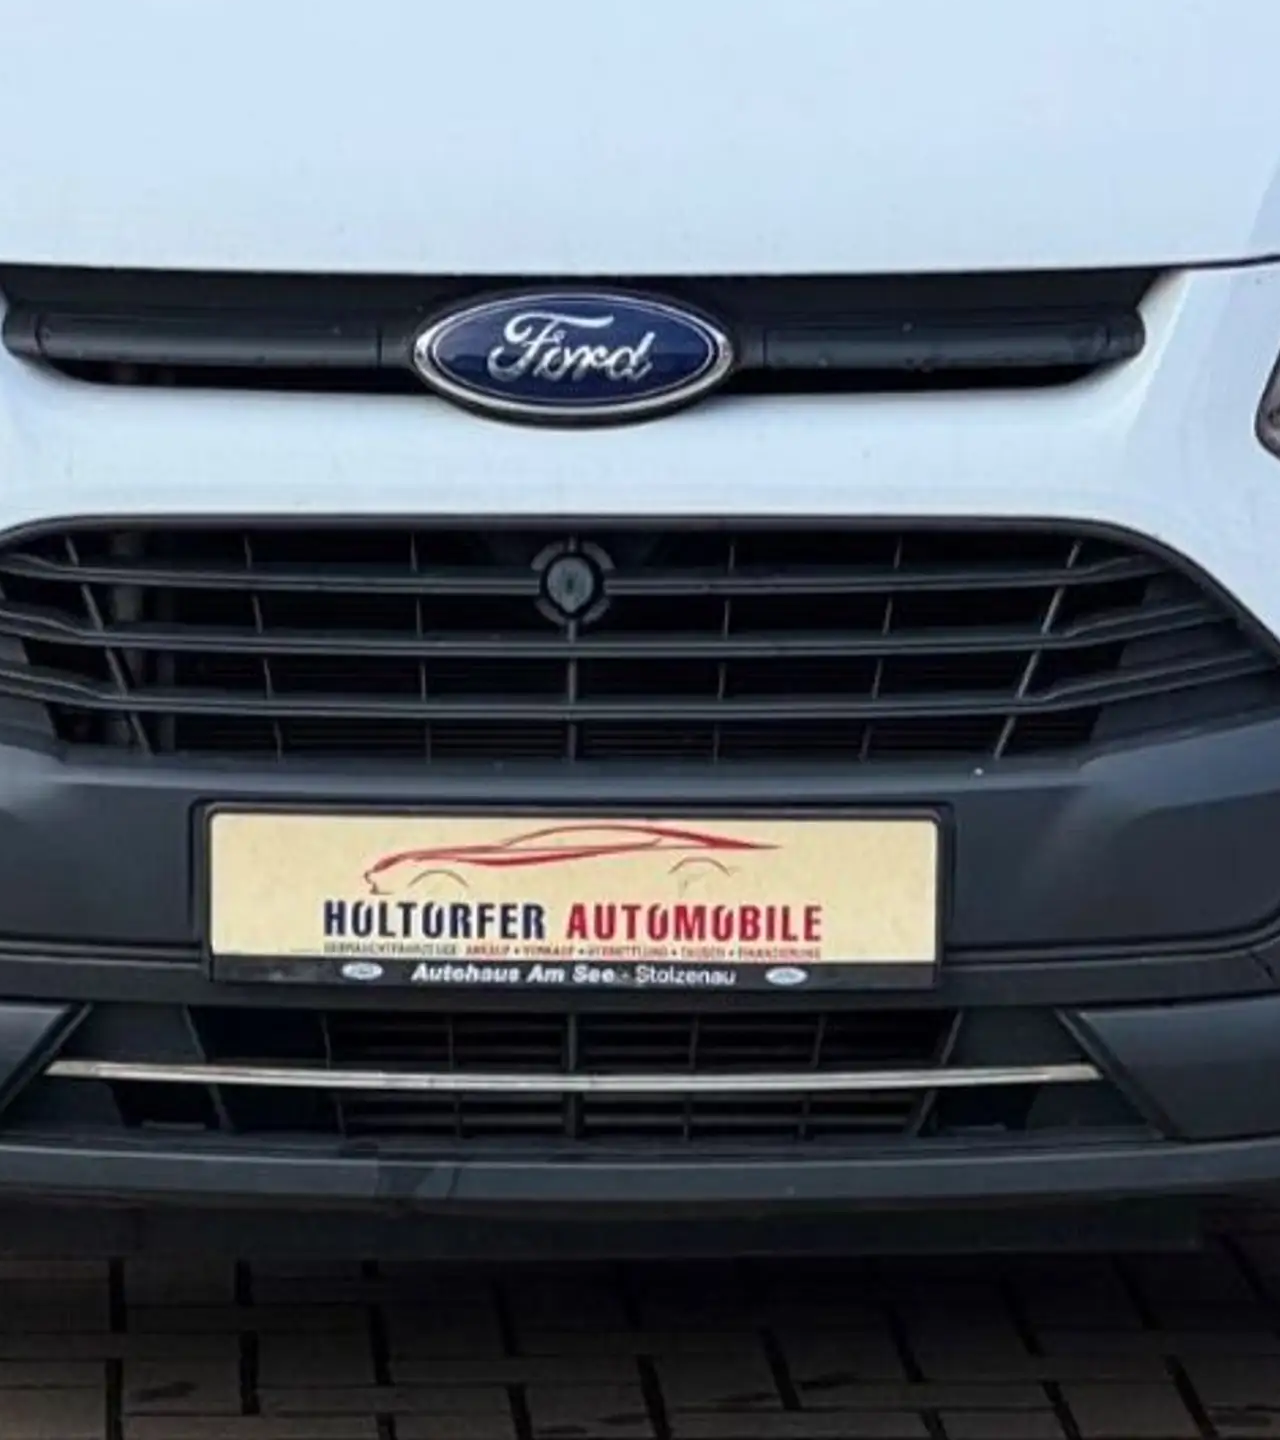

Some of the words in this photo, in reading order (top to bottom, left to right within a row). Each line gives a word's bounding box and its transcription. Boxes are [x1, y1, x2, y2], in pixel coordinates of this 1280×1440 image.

[487, 311, 656, 382] Ford
[323, 900, 546, 939] HOLTORFER
[565, 903, 823, 942] AUTOMOBILE
[410, 963, 520, 983] Autohaus
[527, 964, 565, 983] Am
[572, 965, 615, 984] See
[635, 965, 737, 986] Stolzenau
